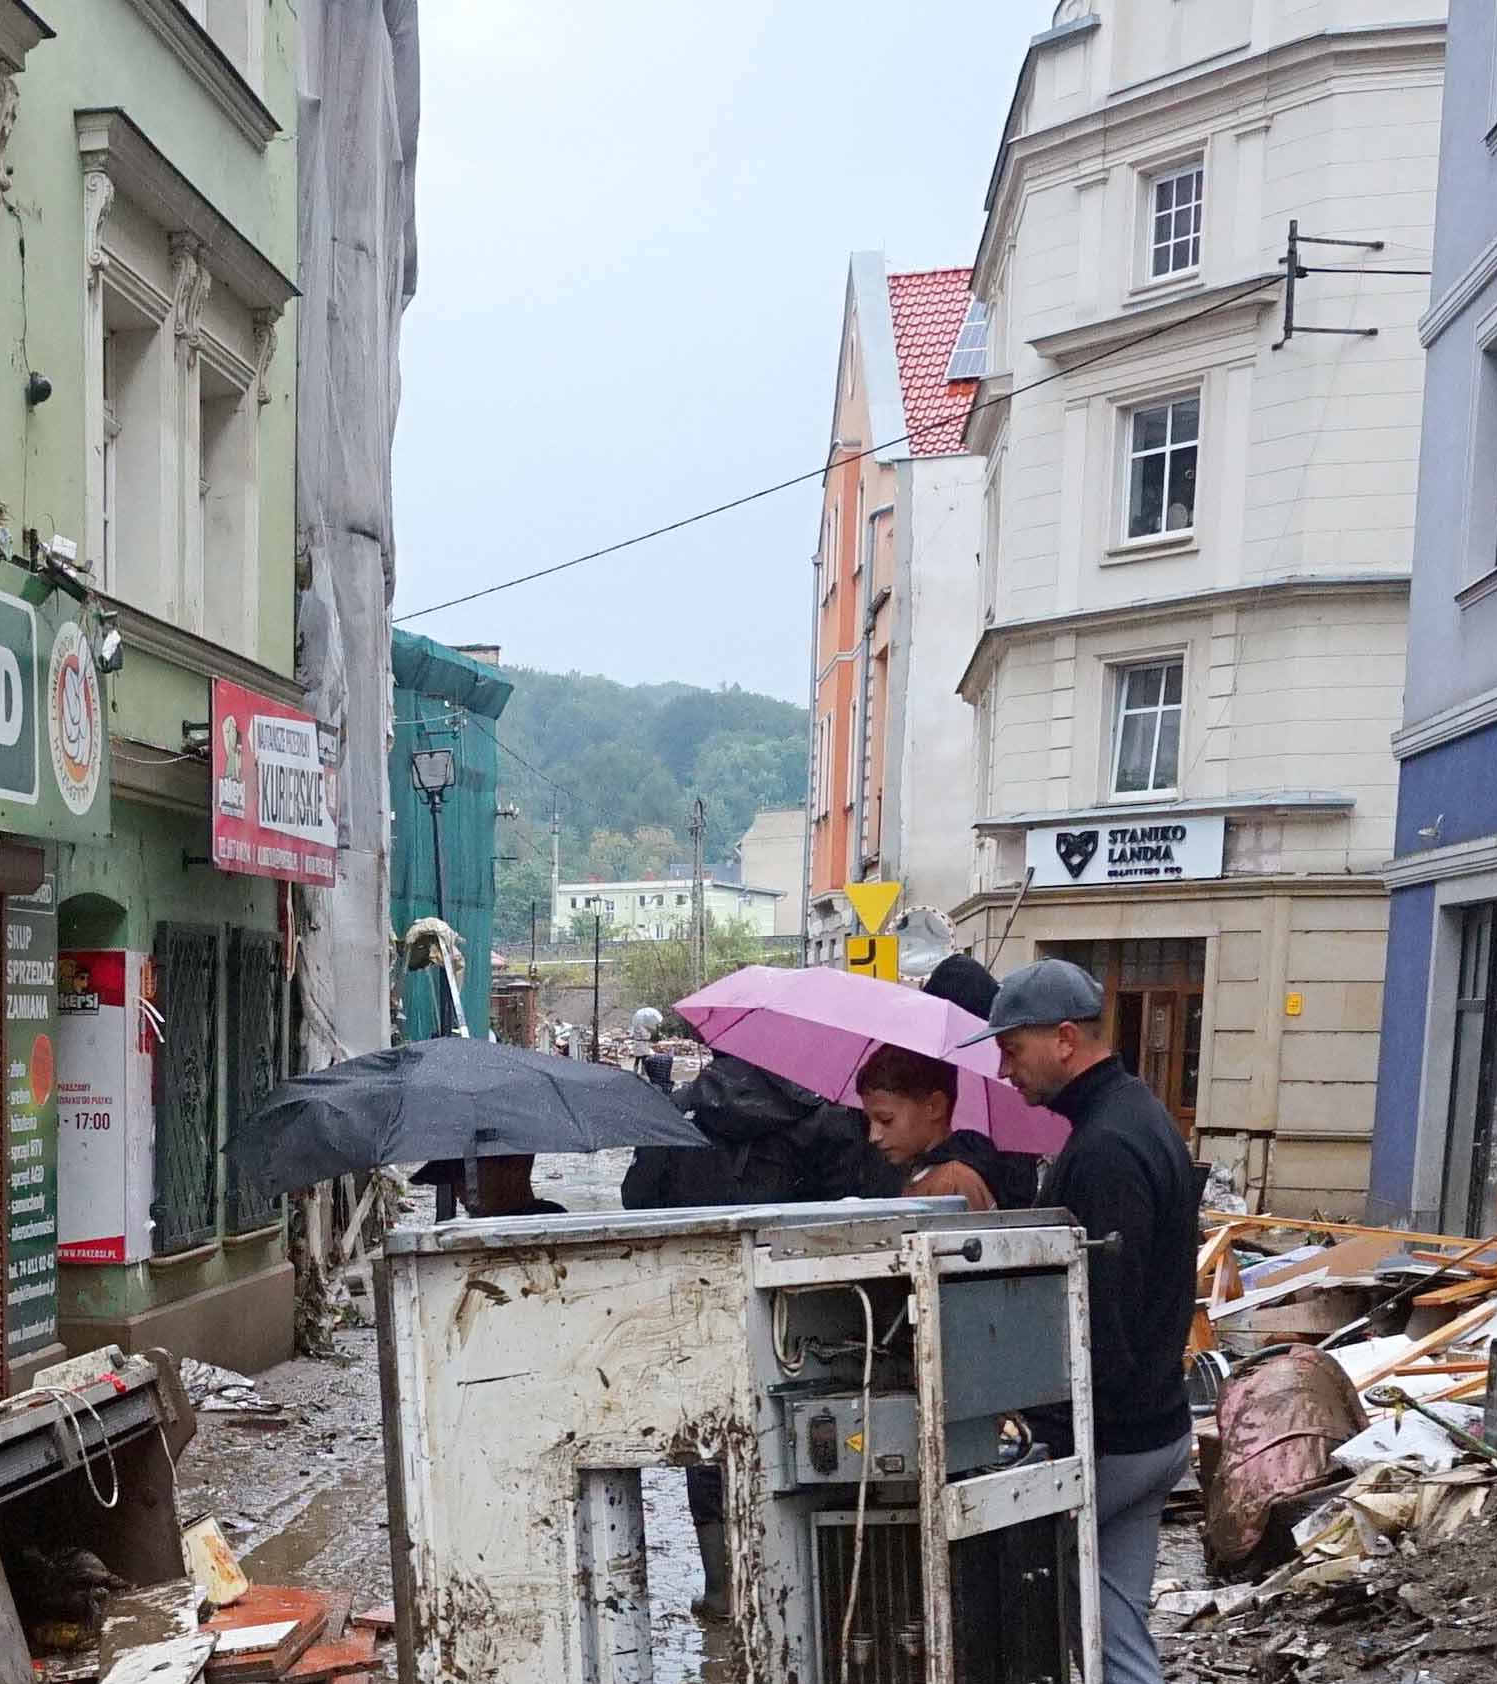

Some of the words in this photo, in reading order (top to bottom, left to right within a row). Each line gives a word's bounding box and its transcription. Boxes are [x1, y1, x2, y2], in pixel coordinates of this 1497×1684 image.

[261, 762, 324, 828] KURIERSKIE
[1108, 825, 1187, 846] STANIKO
[1108, 845, 1174, 864] LANDIA
[6, 924, 32, 950] SKUP
[6, 956, 54, 986] SPRZEDAŻ
[6, 994, 49, 1019] ZAMIANA
[75, 1112, 110, 1130] 17:00
